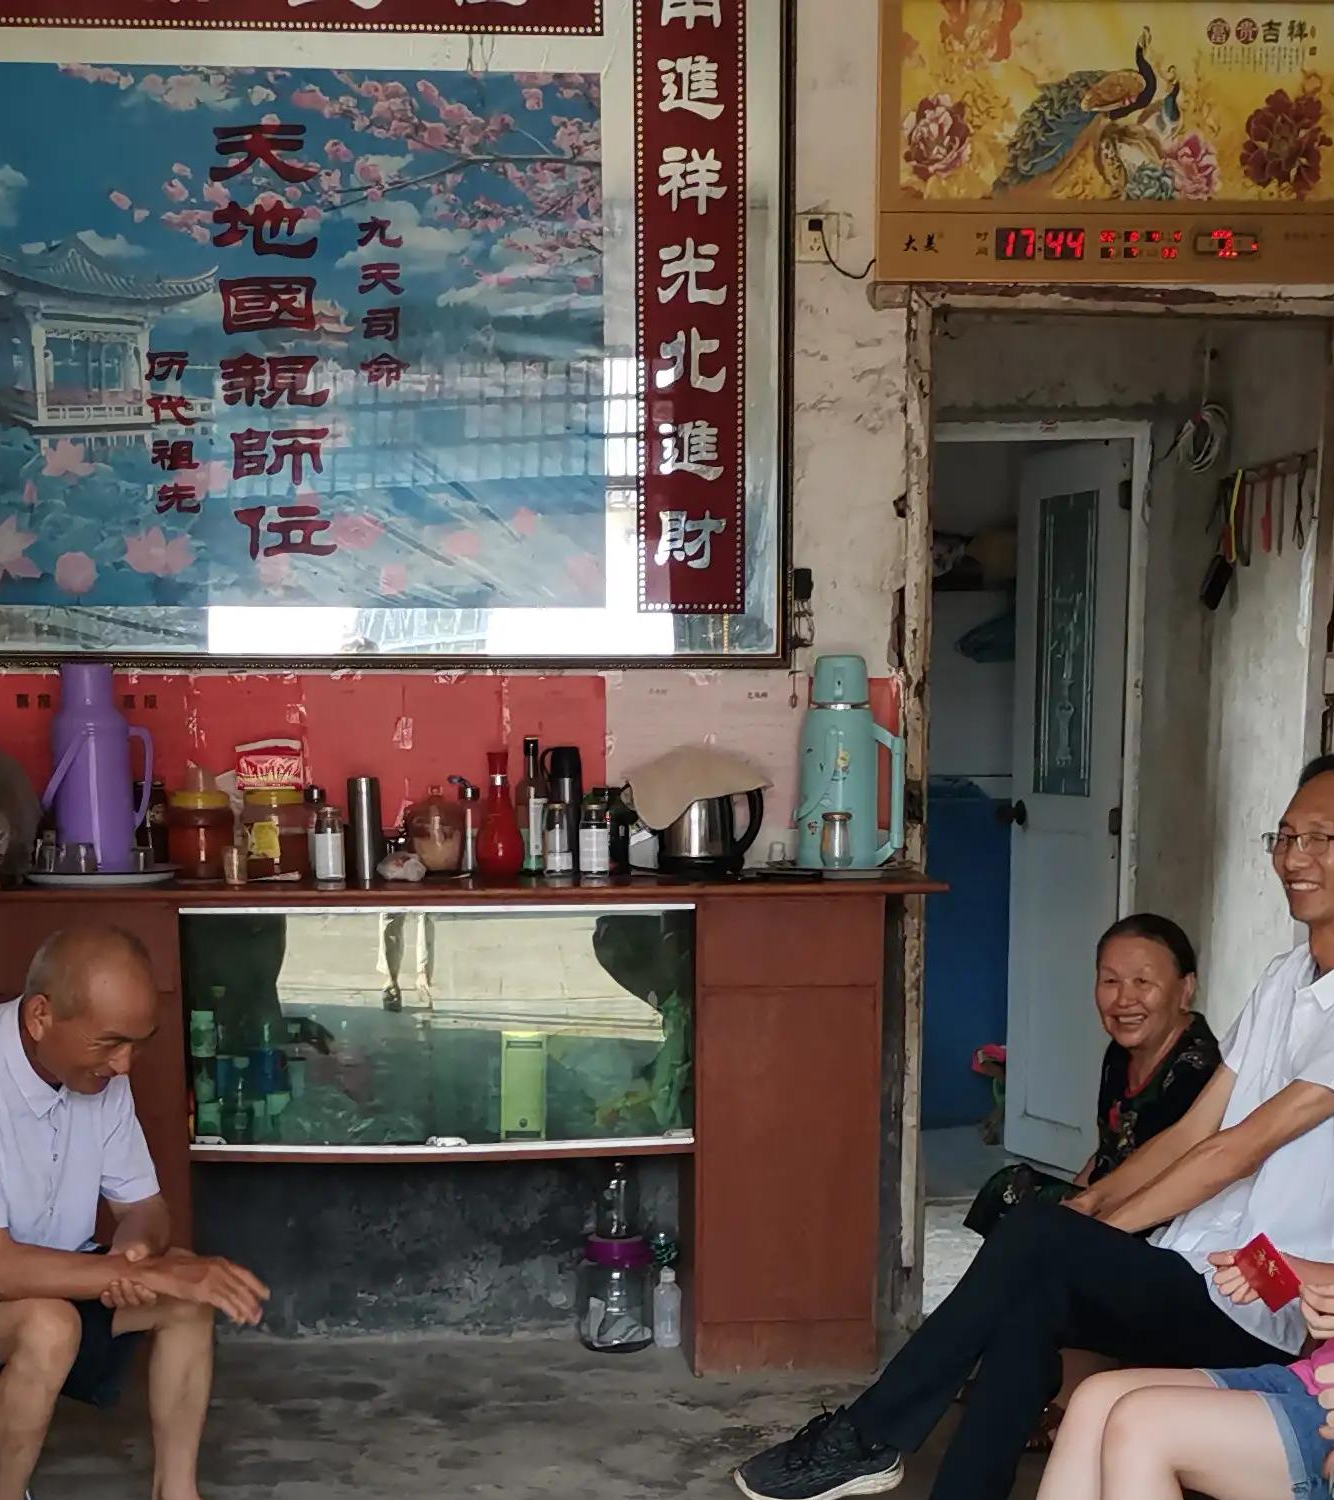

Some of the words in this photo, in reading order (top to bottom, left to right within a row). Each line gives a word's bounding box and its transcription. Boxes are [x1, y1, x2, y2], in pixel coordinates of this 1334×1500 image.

[208, 123, 339, 562] 天地國親師位
[357, 215, 411, 388] 九天司命
